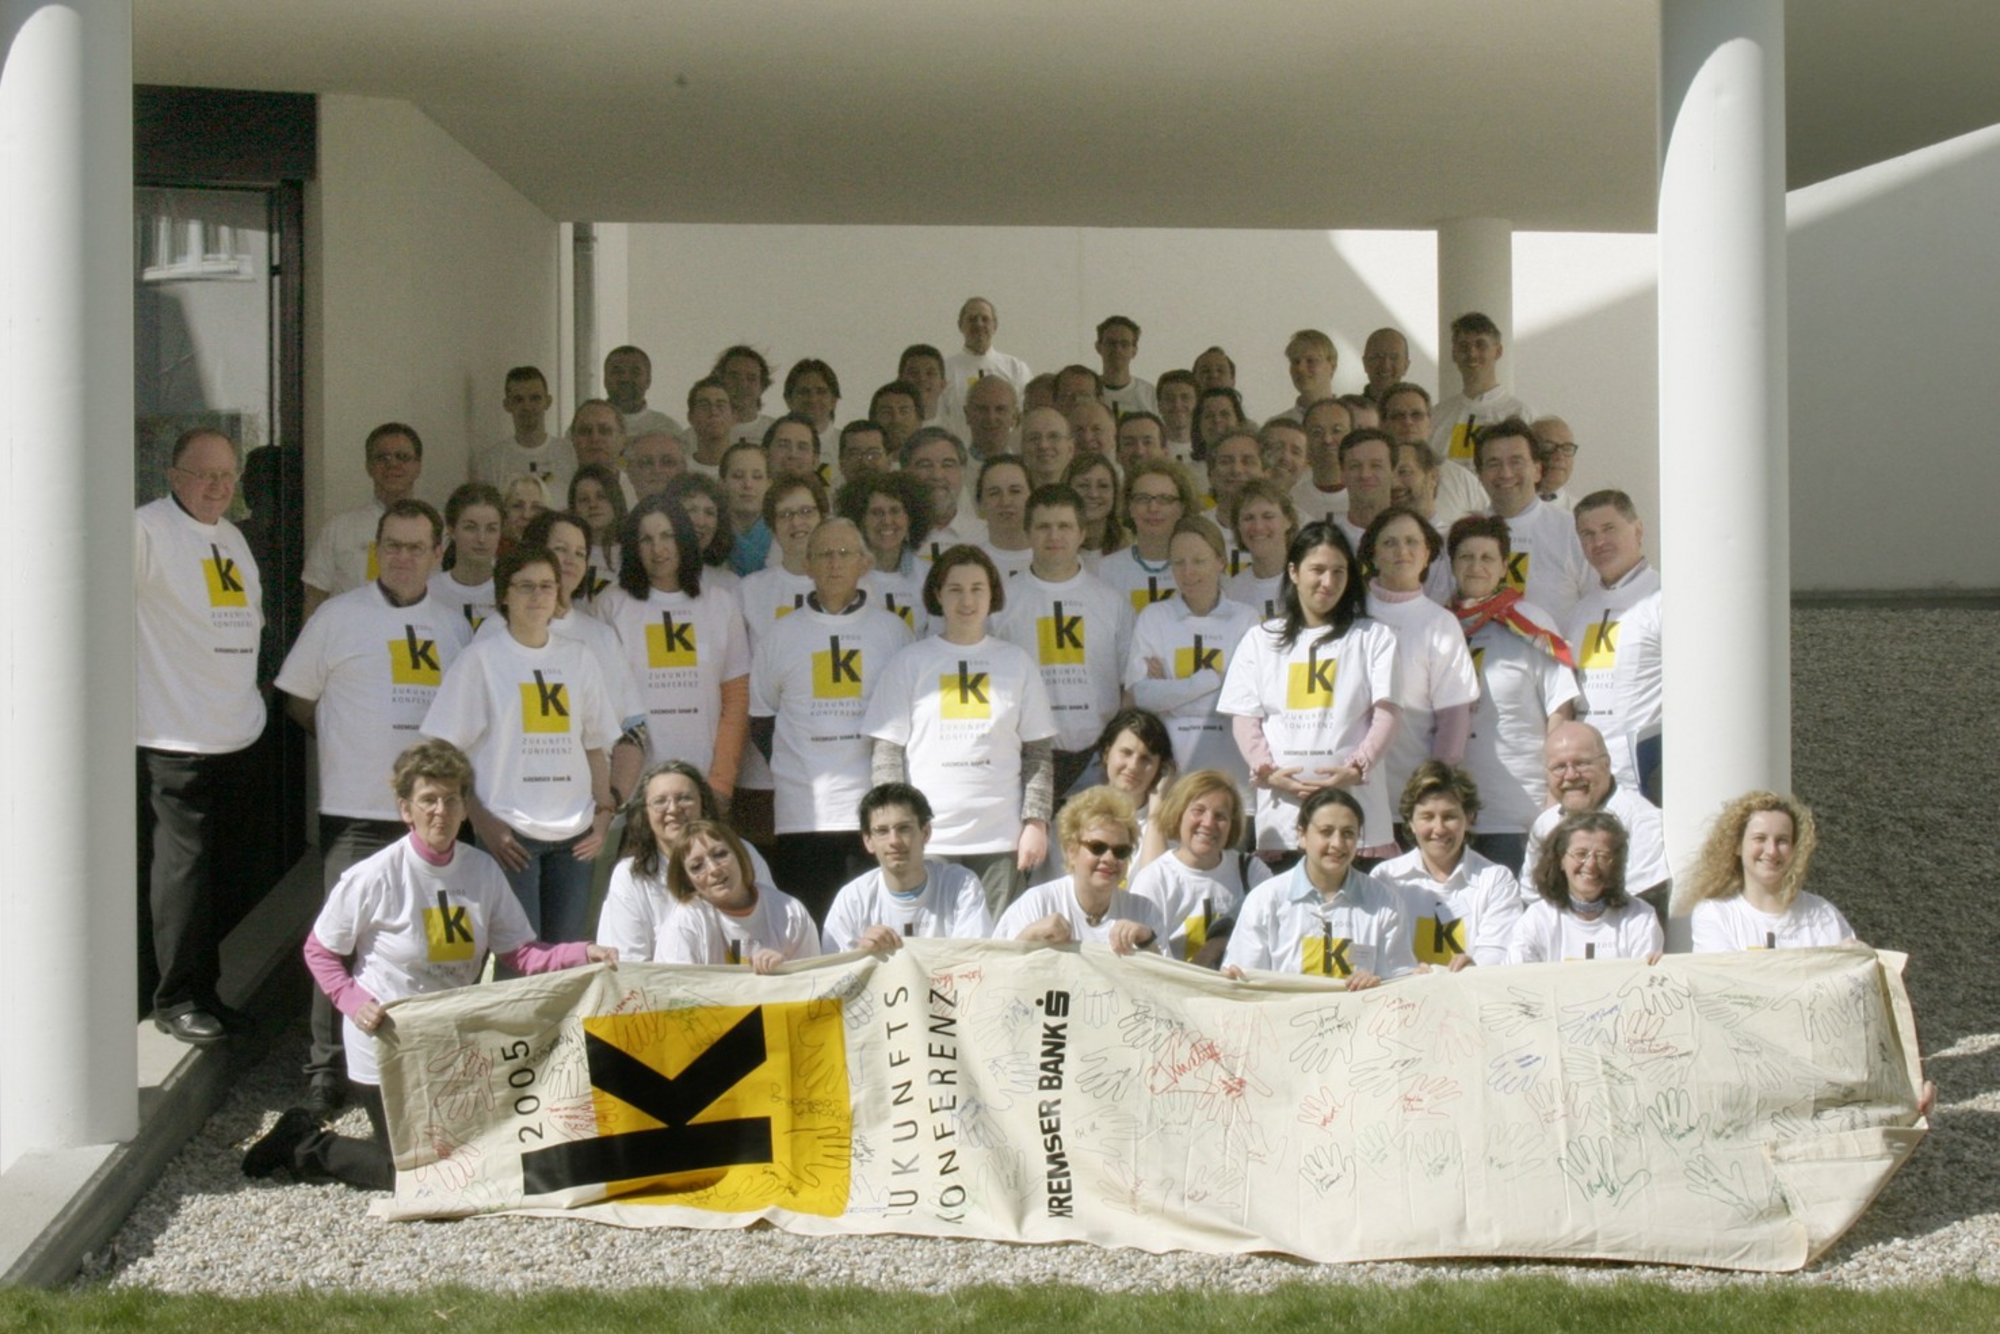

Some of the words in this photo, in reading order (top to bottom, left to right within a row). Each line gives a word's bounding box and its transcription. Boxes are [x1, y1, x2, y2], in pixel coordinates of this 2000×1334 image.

[662, 610, 696, 653] k
[829, 635, 862, 683] k
[958, 660, 989, 704] k
[533, 669, 570, 716] k
[437, 889, 474, 943] k
[1038, 1022, 1068, 1091] BANK
[501, 1041, 543, 1143] 2005
